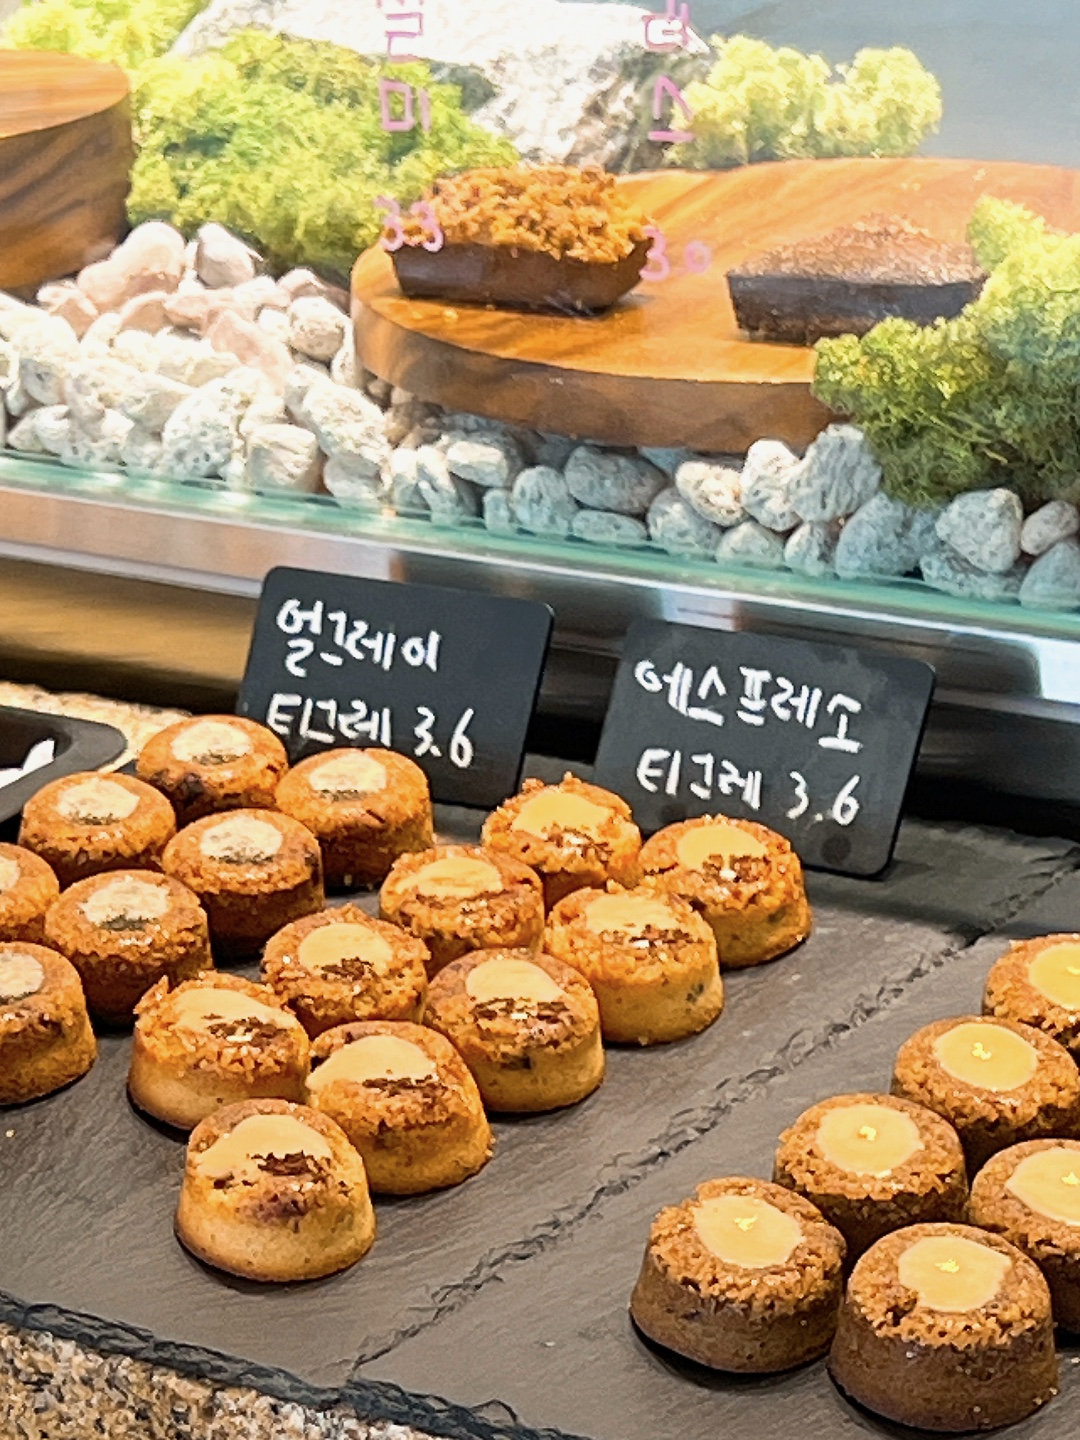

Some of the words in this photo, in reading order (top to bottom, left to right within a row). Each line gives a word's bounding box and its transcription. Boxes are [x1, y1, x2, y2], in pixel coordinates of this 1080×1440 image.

[276, 599, 441, 677] 얼그레이
[267, 693, 392, 747] 티그레
[413, 706, 474, 768] 3.6
[634, 660, 863, 754] 에스프레소
[636, 748, 762, 810] 티그레
[786, 774, 861, 827] 3.6
